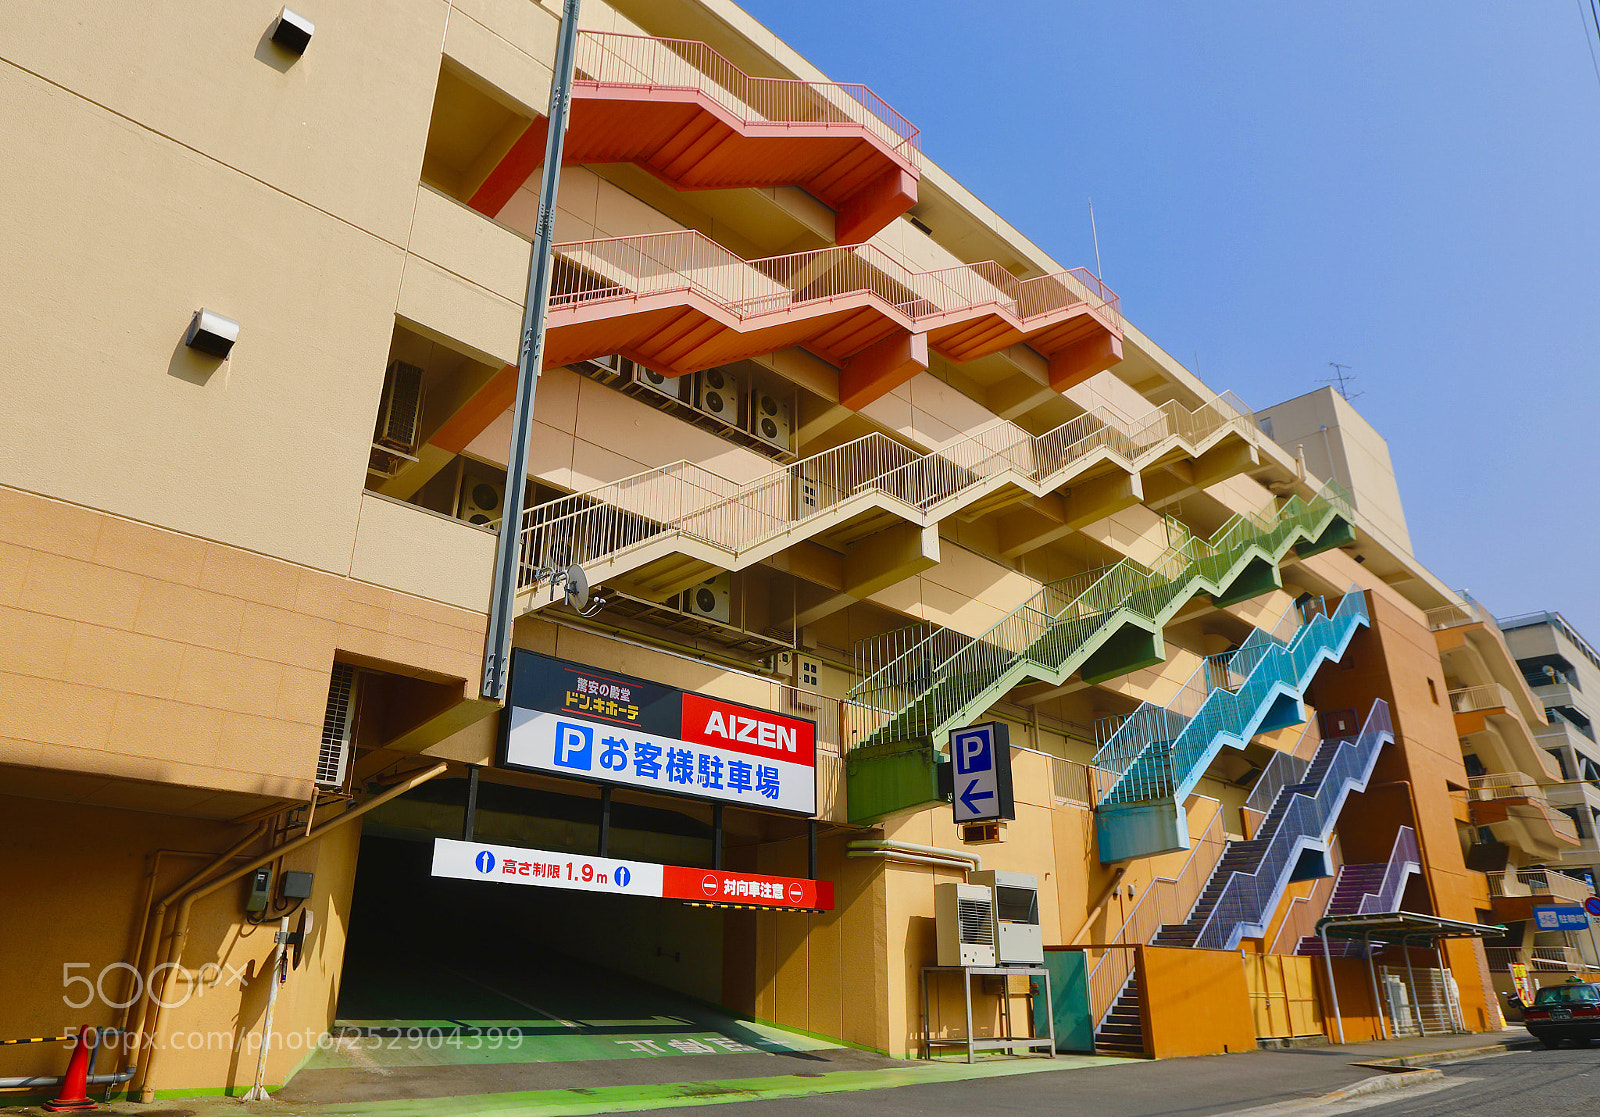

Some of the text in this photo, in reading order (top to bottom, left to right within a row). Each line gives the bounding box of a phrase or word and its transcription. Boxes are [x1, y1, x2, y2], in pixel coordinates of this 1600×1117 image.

[561, 727, 586, 763] P
[703, 710, 797, 753] AIZEN
[599, 736, 781, 800] お客様駐車場
[962, 736, 984, 770] P
[502, 859, 560, 879] 高さ制限
[723, 879, 785, 899] 対向車注意
